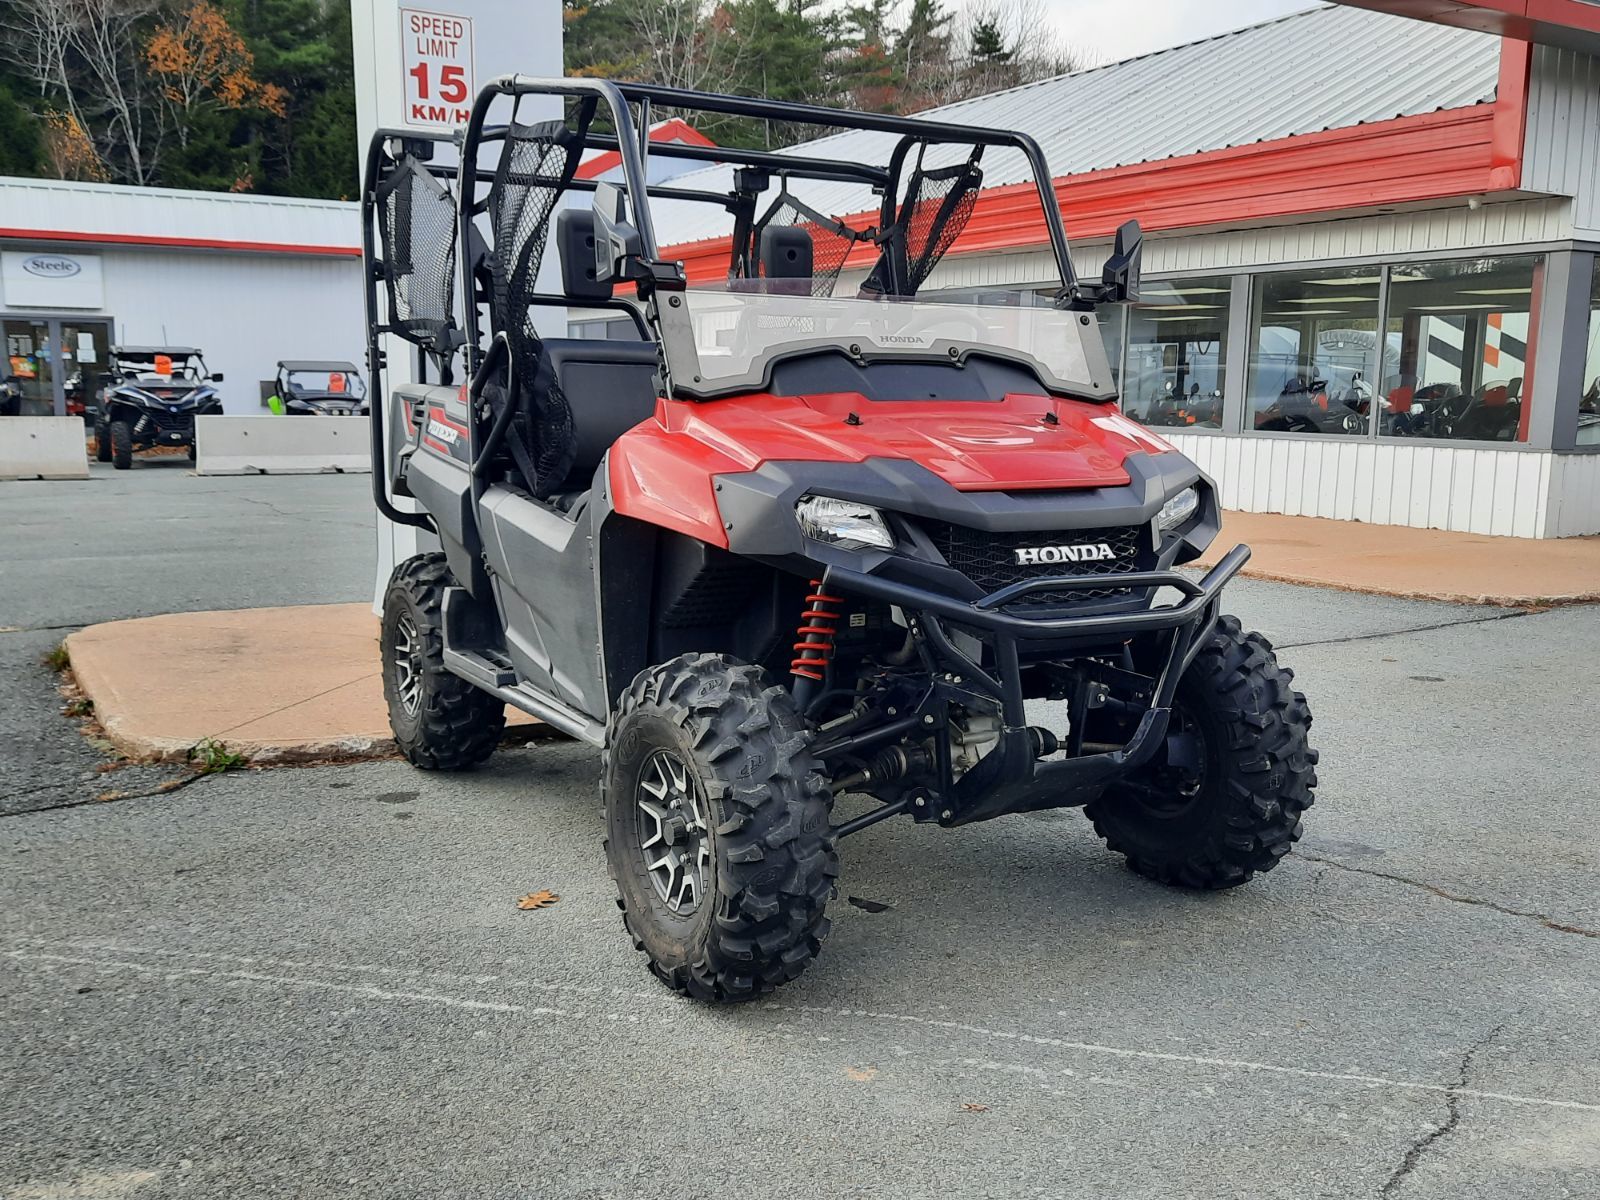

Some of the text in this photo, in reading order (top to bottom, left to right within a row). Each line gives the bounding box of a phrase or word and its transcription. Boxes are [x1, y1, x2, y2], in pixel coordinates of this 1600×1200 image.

[410, 15, 463, 39] SPEED
[416, 38, 458, 59] LIMIT
[410, 62, 467, 104] 15
[411, 104, 470, 124] KM/H
[31, 259, 73, 271] Steele
[880, 335, 924, 344] HONDA
[1015, 543, 1117, 566] HONDA
